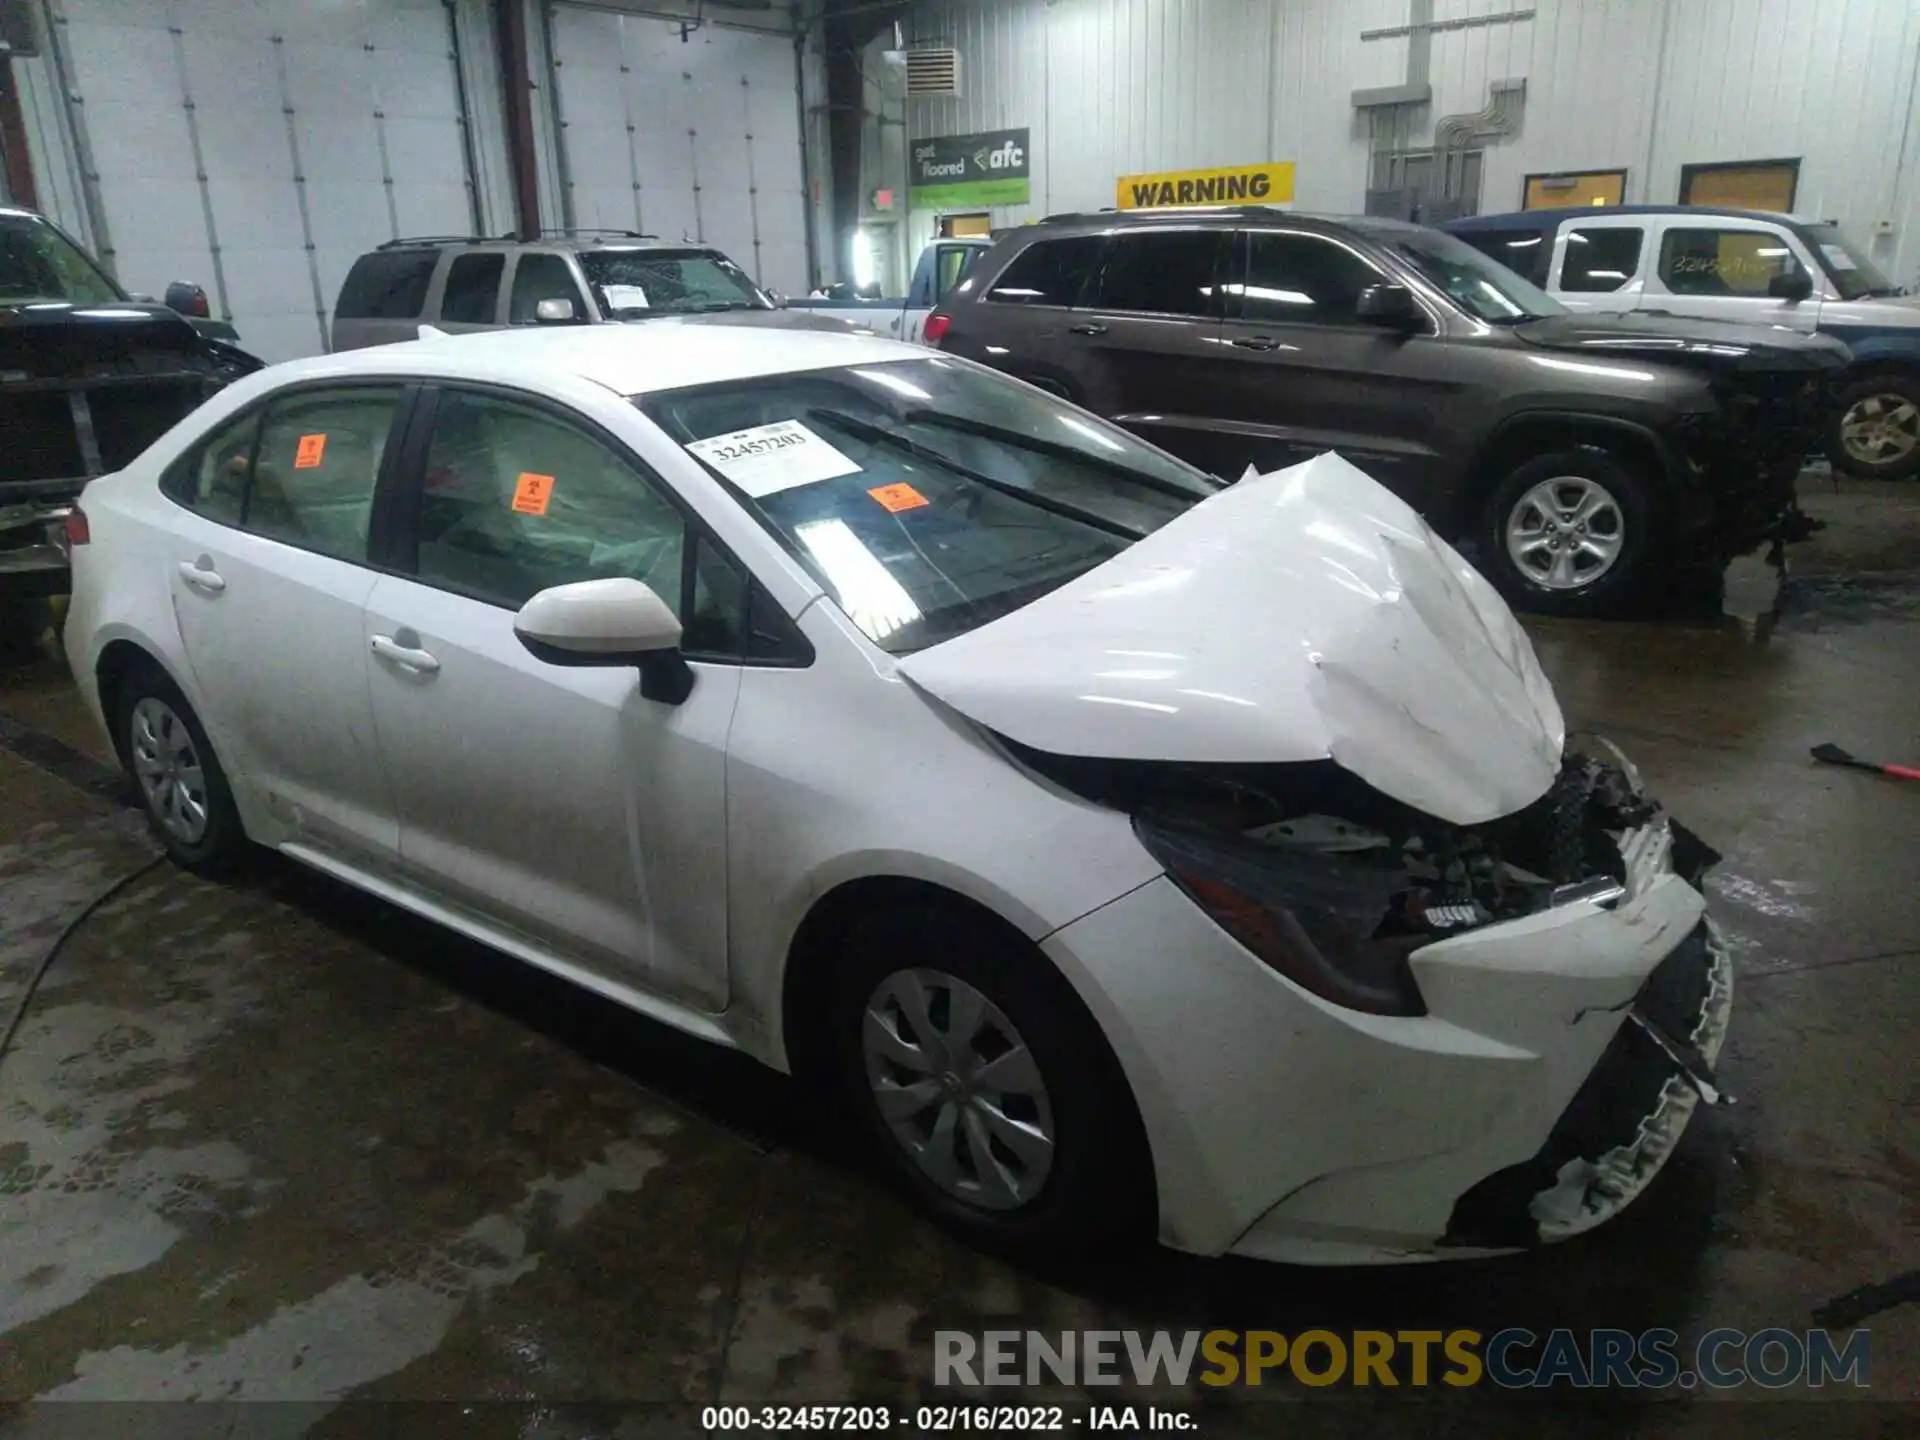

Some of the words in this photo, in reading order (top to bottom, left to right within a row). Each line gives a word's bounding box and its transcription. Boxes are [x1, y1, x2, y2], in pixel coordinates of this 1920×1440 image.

[922, 158, 964, 178] floored
[990, 140, 1023, 168] afc
[1132, 172, 1271, 207] WARNING
[712, 433, 806, 461] 32457203
